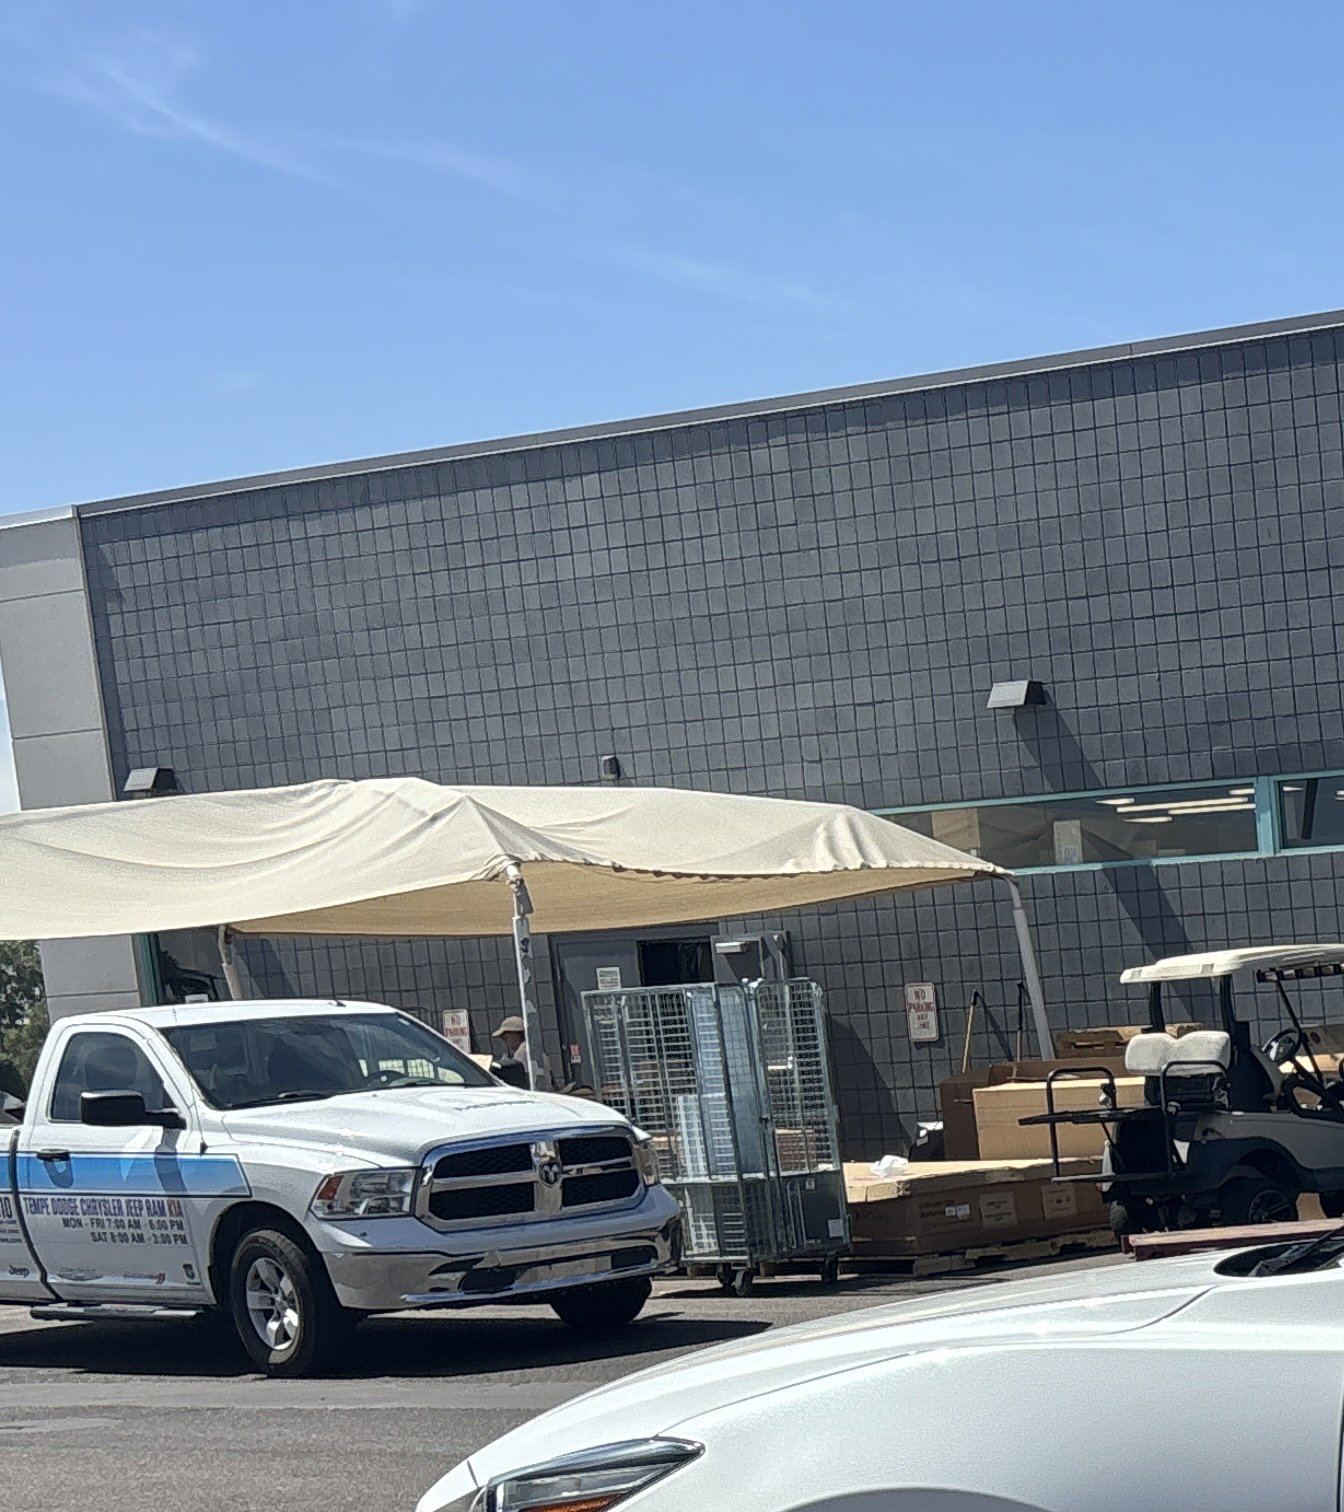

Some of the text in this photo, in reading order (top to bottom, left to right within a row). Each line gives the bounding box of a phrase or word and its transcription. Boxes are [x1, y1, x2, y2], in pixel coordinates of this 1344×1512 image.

[914, 989, 926, 1000] NO
[23, 1197, 184, 1217] TEMPE DODGE CHRYSLER JEEP RAM KIA
[62, 1217, 83, 1228] MON
[90, 1218, 105, 1229] FRI
[127, 1219, 141, 1230] AM
[170, 1219, 185, 1230] PM
[90, 1231, 107, 1242] SAT
[131, 1232, 146, 1243] AM
[173, 1234, 188, 1245] PM
[8, 1264, 30, 1278] Jeep
